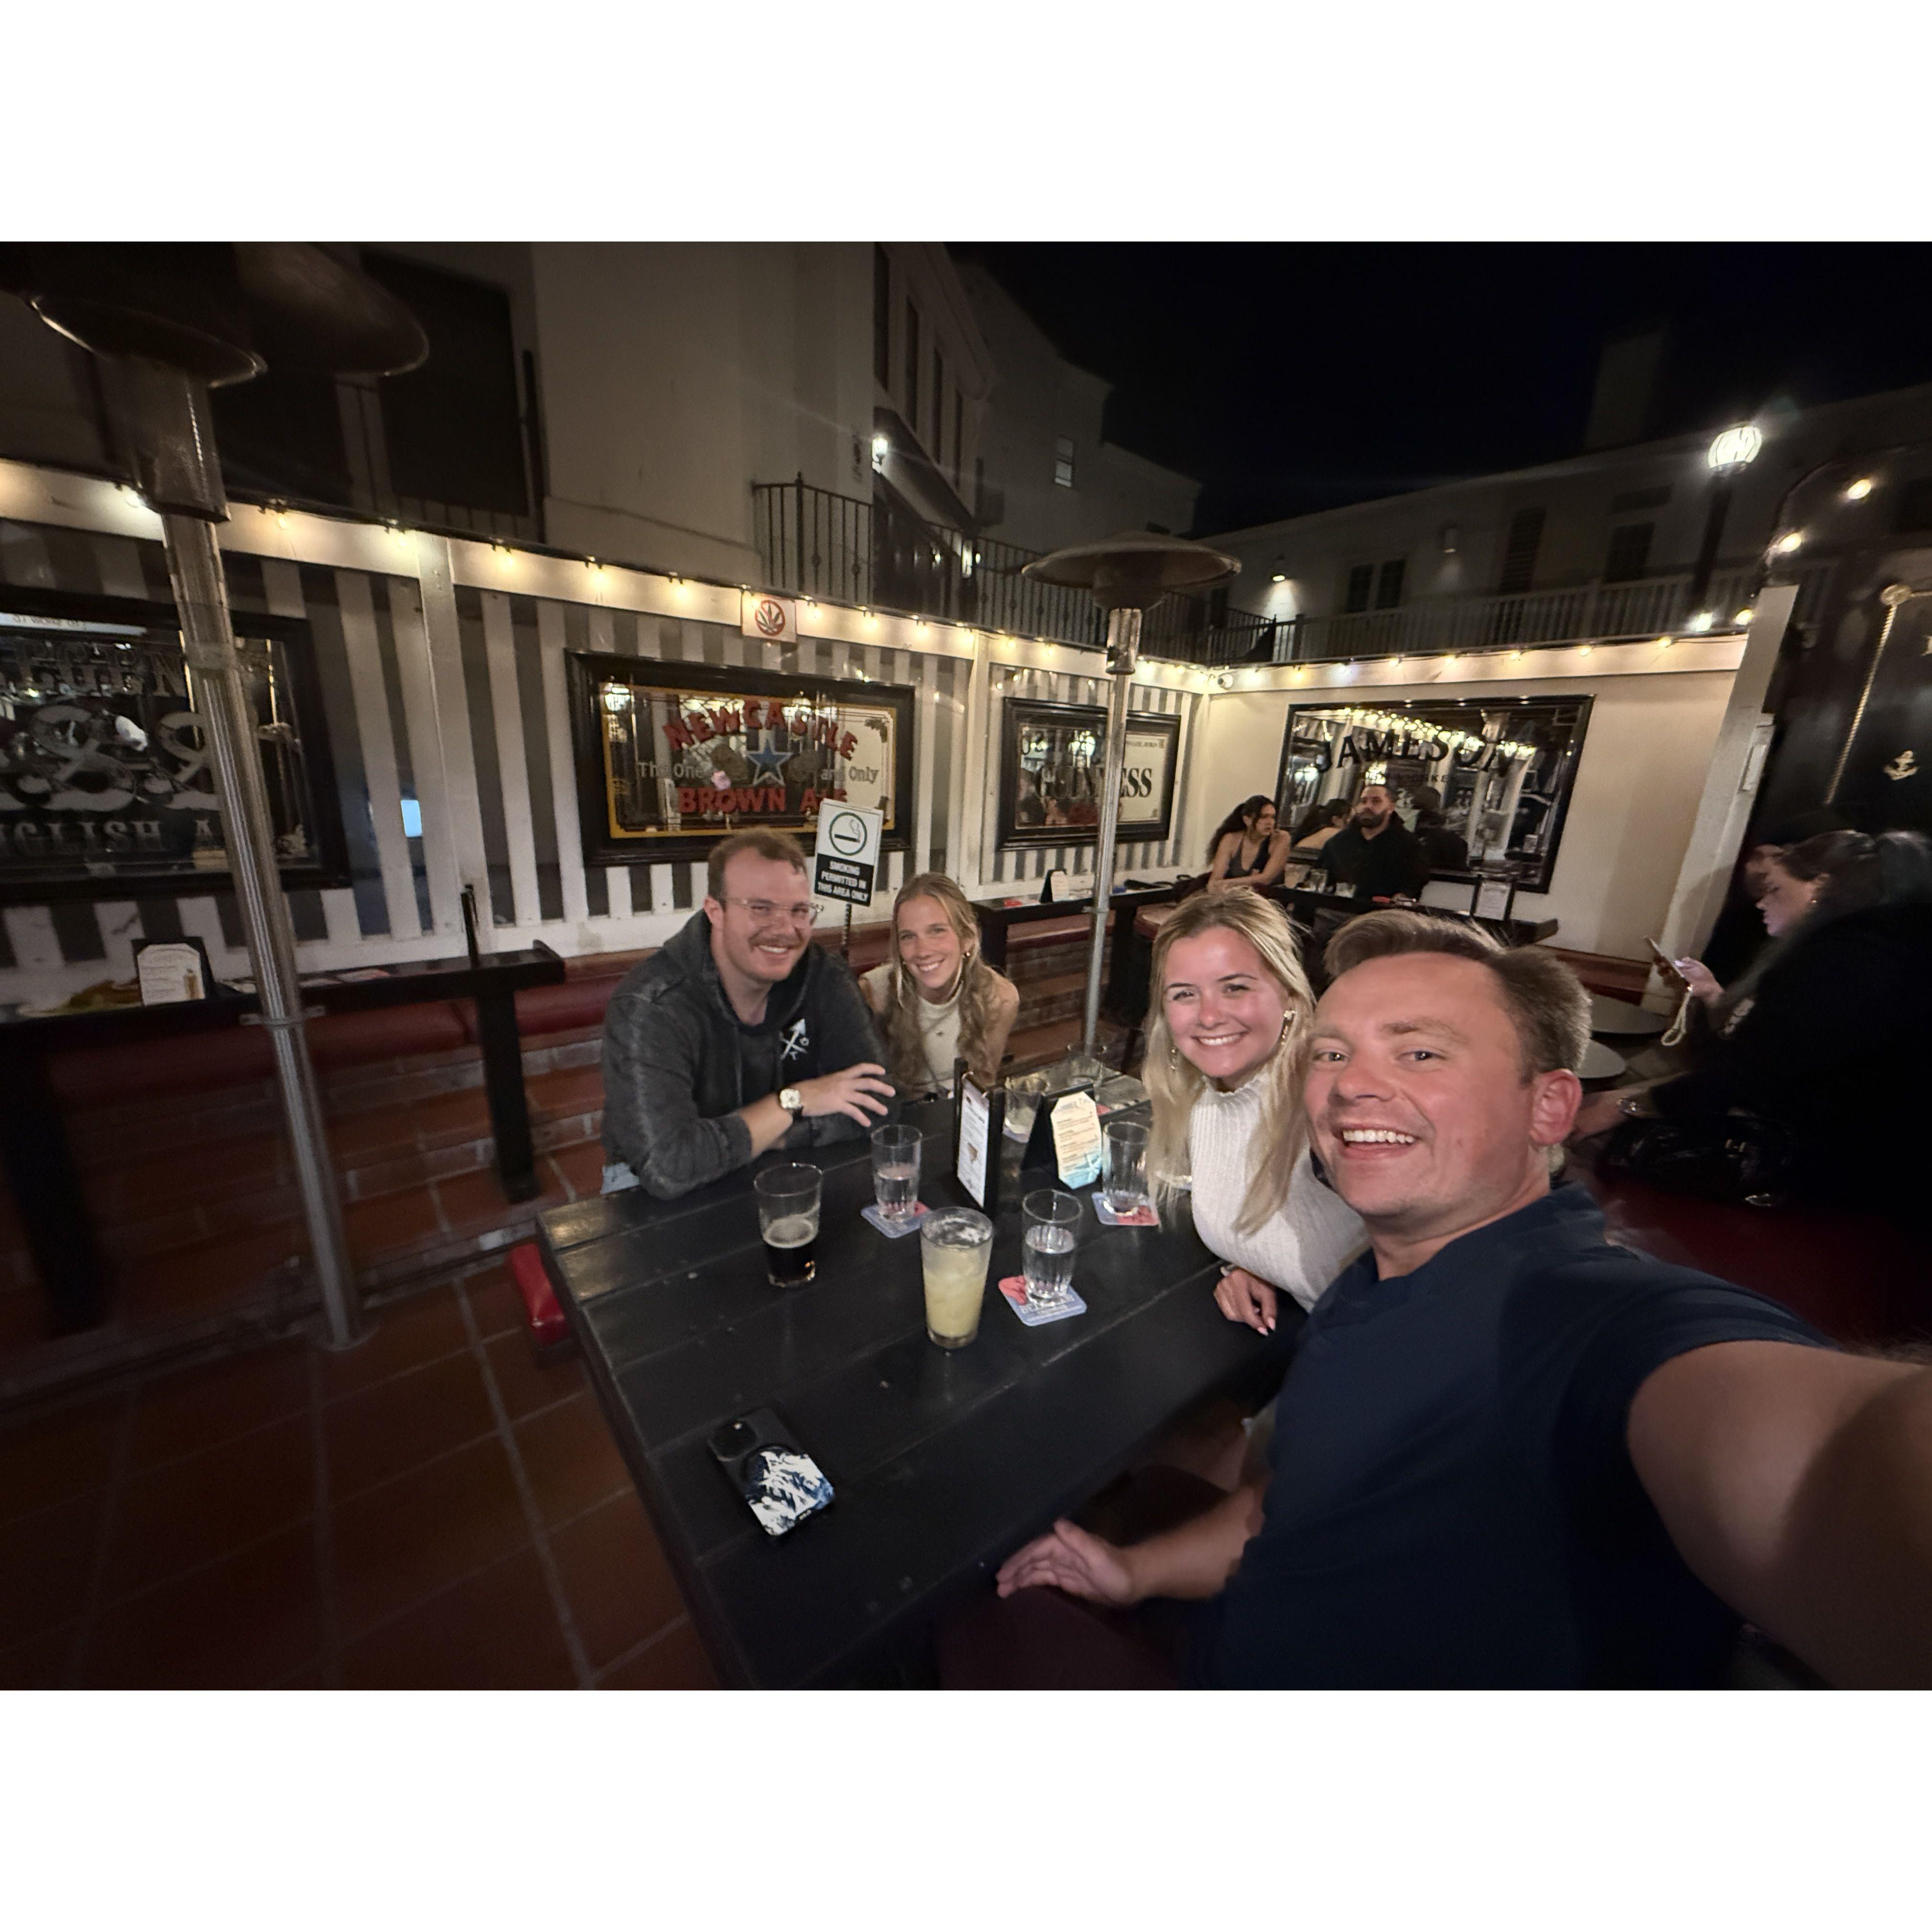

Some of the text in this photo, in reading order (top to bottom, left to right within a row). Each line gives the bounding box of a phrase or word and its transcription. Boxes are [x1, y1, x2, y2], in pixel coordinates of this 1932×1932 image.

[663, 700, 858, 760] NEWCASTLE
[674, 763, 705, 779] One
[849, 766, 879, 784] Only
[678, 787, 786, 814] BROWN
